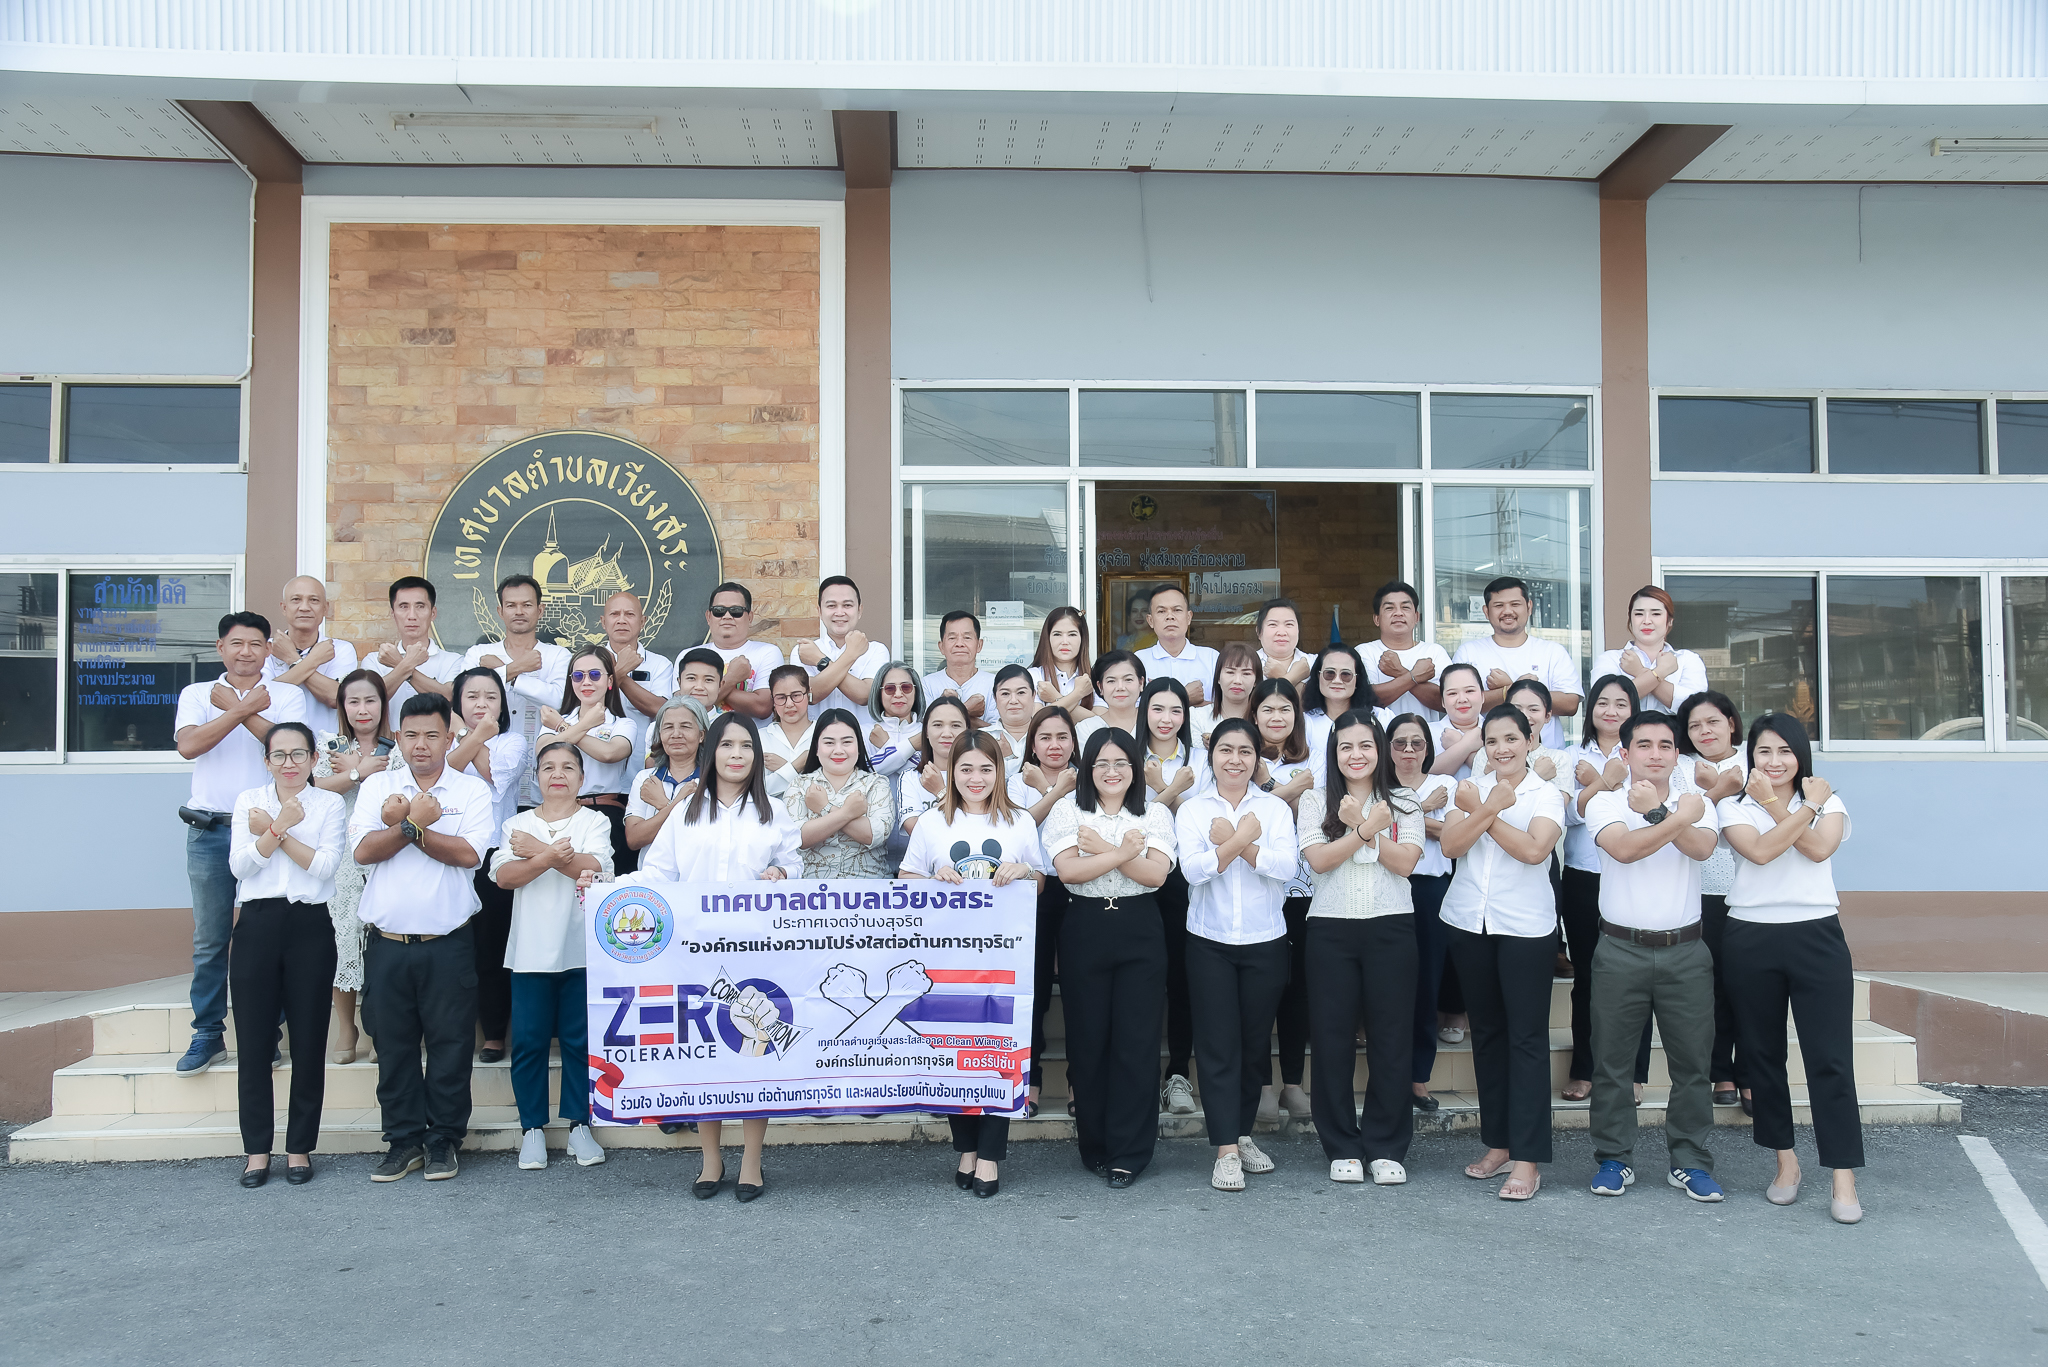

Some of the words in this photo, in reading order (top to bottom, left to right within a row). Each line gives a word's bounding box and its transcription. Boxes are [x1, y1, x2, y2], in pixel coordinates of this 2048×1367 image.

[453, 448, 689, 580] เทศบาลตำบลเวียงสระ
[1097, 547, 1131, 572] สุจริต
[1139, 544, 1246, 571] มุ่งสัมฤทธิ์ของงาน
[94, 576, 186, 605] สำนักปลัด
[77, 607, 127, 622] งานธุรการ
[78, 619, 163, 634] งานประชาสัมพันธ์
[77, 637, 156, 652] งานการเจ้าหน้าที่
[77, 655, 126, 669] งานนิติกร
[77, 671, 155, 686] งานงบประมาณ
[78, 690, 180, 705] งานวิเคราะห์นโยบายแ
[602, 889, 668, 918] เทศบาลตำบลเวียงสระ
[701, 883, 994, 913] เทศบาลตำบลเวียงสระ
[773, 913, 923, 931] ประกาศเจตจำนงสุจริต
[602, 978, 794, 1057] ZERO
[817, 1034, 943, 1047] เทศบาลตำบลเวียงสระใสสะอาด
[945, 1036, 972, 1047] Clean
[974, 1037, 1001, 1049] Wiang
[1002, 1037, 1018, 1049] Sra
[603, 1044, 717, 1063] TOLERANCE
[815, 1053, 954, 1070] องค์กรไม่ทนต่อการทุจริต
[963, 1052, 1016, 1070] คอร์รัปชั่น
[620, 1095, 652, 1111] ร่วมใจ
[656, 1091, 695, 1108] ป้องกัน
[698, 1090, 754, 1106] ปราบปราม
[758, 1085, 842, 1104] ต่อต้านการทุจริต
[846, 1082, 1006, 1103] และผลประโยชน์ทับซ้อนทุกรูปแบบ
